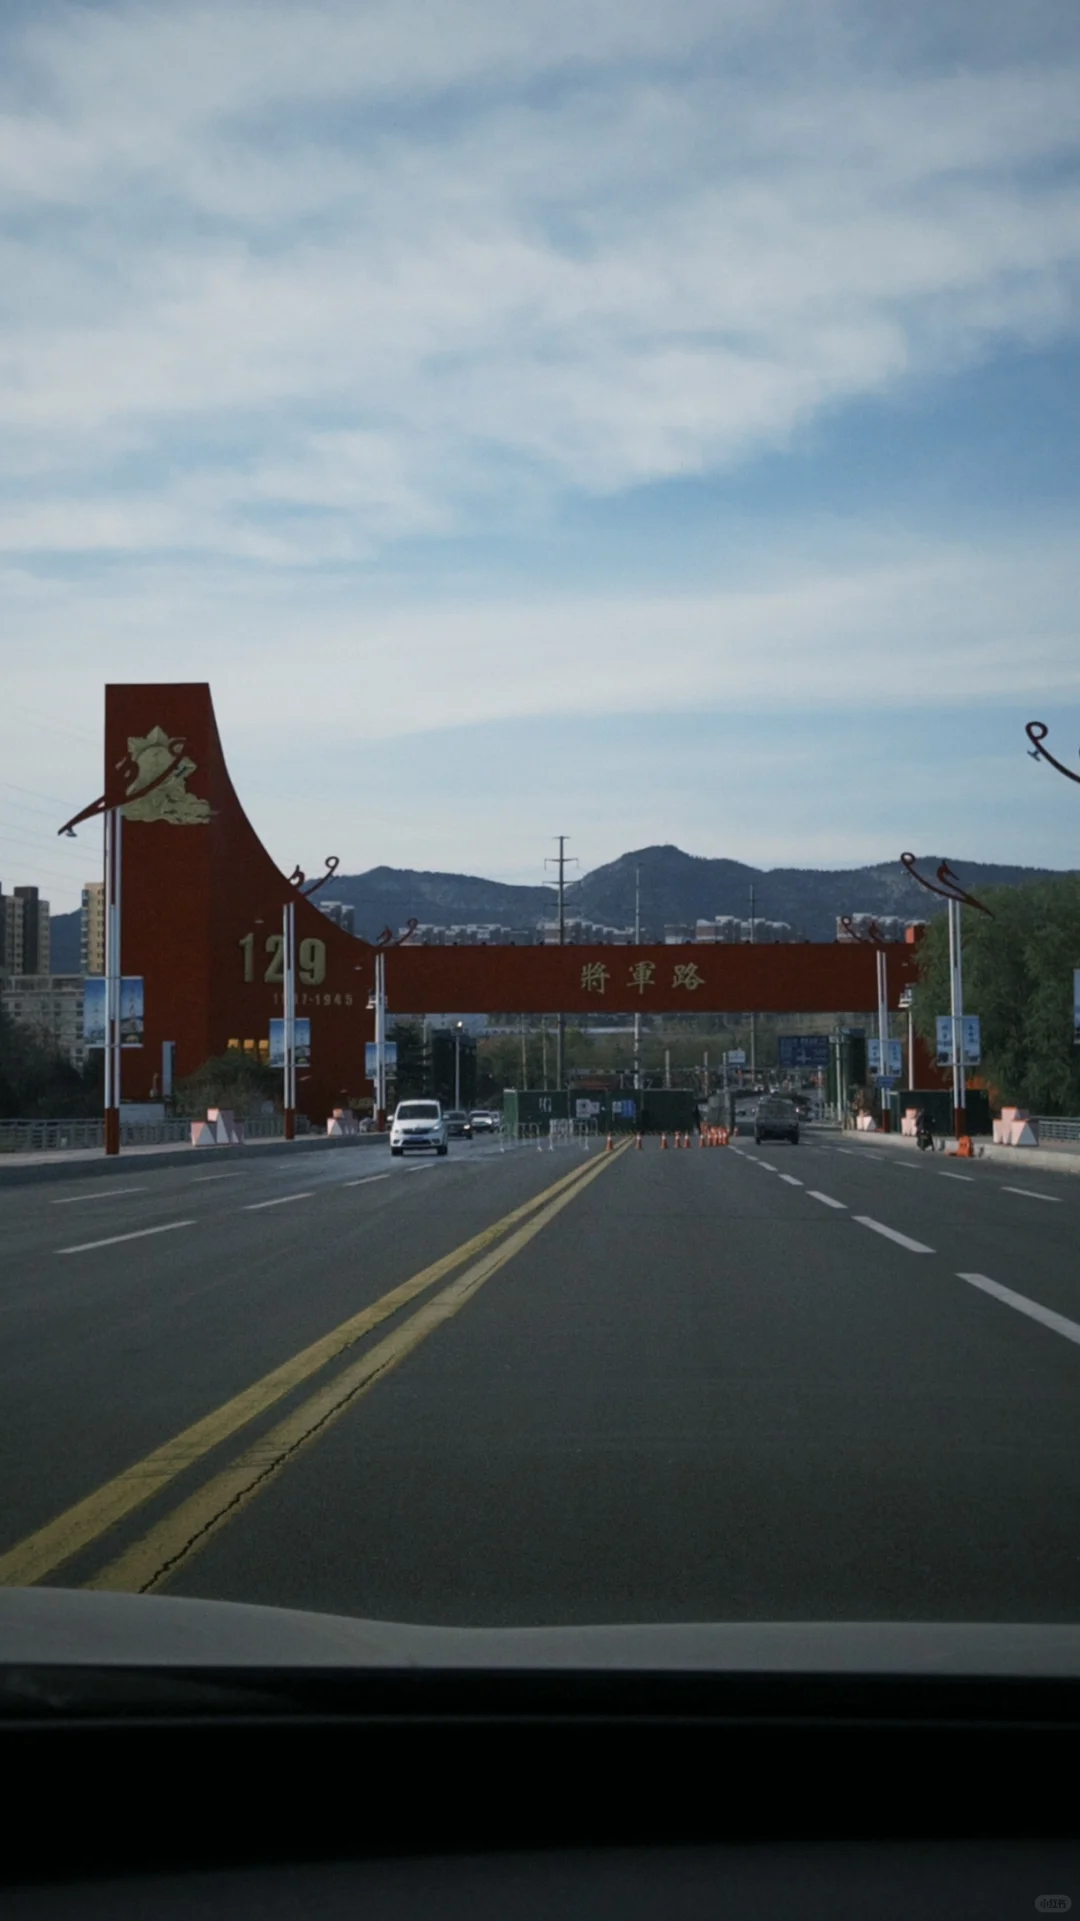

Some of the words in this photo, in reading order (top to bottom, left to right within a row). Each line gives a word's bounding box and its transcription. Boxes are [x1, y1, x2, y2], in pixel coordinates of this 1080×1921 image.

[238, 932, 326, 985] 129
[580, 961, 706, 994] 將軍路
[273, 992, 353, 1006] 17-1945
